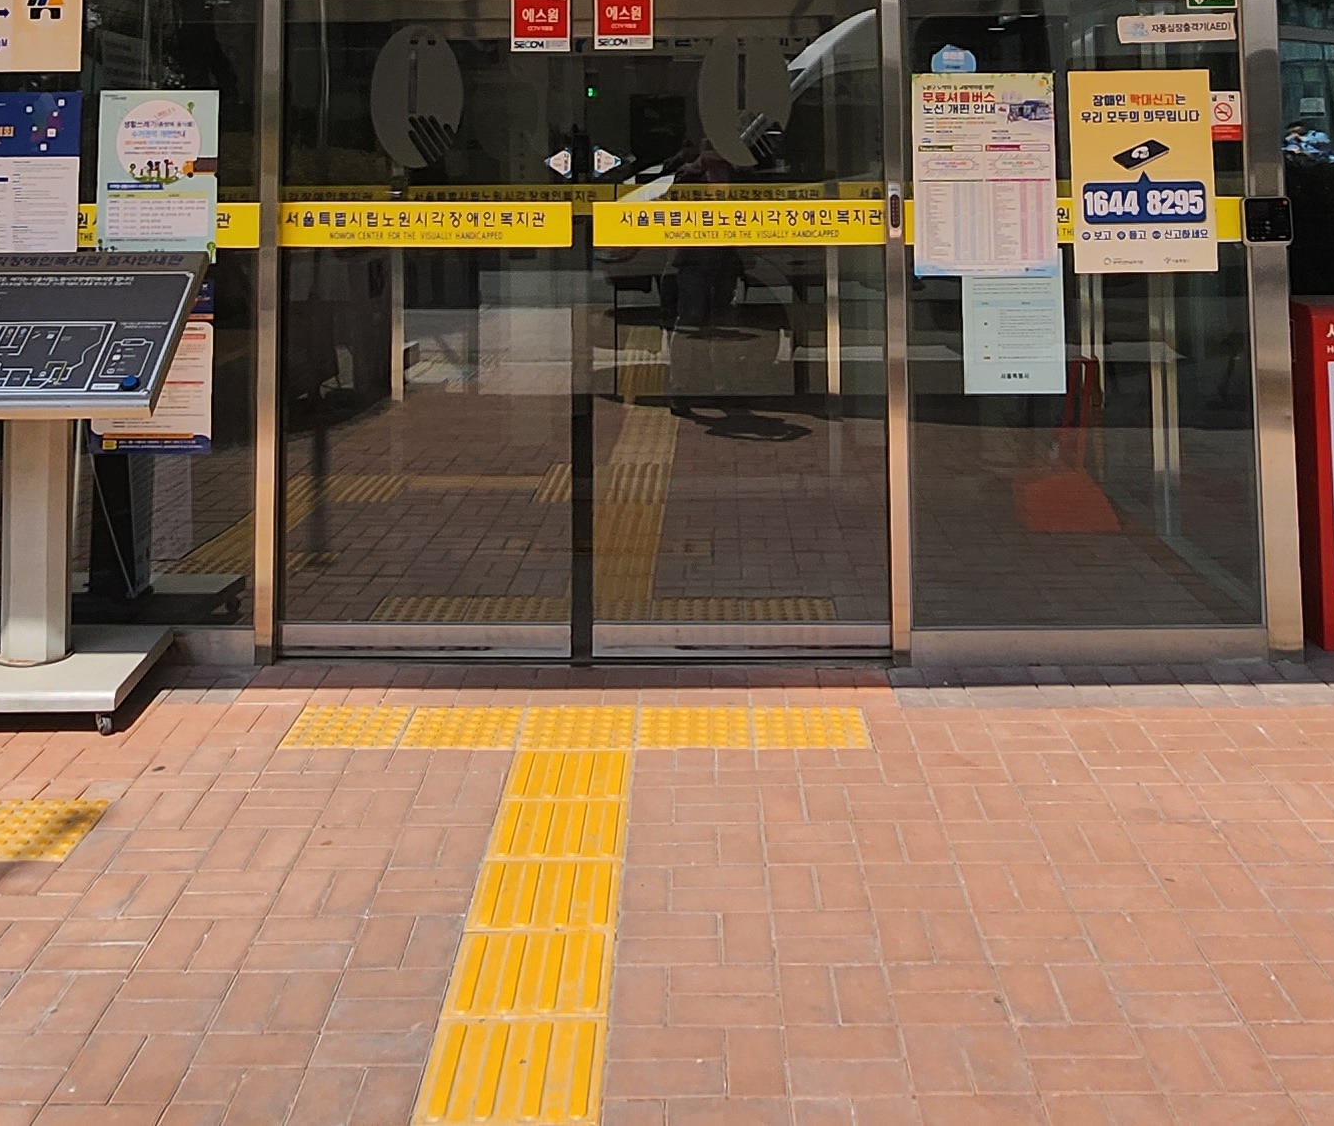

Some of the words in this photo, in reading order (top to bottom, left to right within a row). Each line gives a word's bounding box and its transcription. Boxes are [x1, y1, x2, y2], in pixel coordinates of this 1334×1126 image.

[522, 7, 558, 23] 에스원
[605, 5, 641, 21] 에스원
[1151, 21, 1231, 33] 자동심장충격기(AED)
[514, 41, 544, 49] SECOM
[598, 38, 627, 46] SECOM
[922, 91, 995, 103] 무료셔틀버스
[1092, 94, 1126, 106] 장애인
[1129, 94, 1186, 106] 학대신고는
[923, 104, 944, 114] 노선
[947, 104, 969, 114] 개편
[973, 103, 996, 114] 안내
[1081, 111, 1102, 123] 우리
[1106, 111, 1139, 123] 모두의
[1143, 110, 1199, 122] 의무입니다
[1084, 190, 1139, 216] 1644
[1147, 189, 1204, 215] 8295
[285, 211, 546, 228] 서울특별시립노원시각장애인복지관
[620, 209, 883, 227] 서울특별시립노원시각장애인복지관
[1057, 207, 1070, 223] 원
[329, 231, 356, 241] NOWON
[358, 231, 384, 241] CENTER
[388, 231, 401, 241] FOR
[403, 231, 416, 241] THE
[420, 231, 452, 241] VISUALLY
[455, 231, 503, 241] HANDICAPPED
[664, 230, 692, 239] NOWON
[693, 230, 719, 239] CENTER
[723, 230, 737, 239] FOR
[739, 230, 752, 239] THE
[757, 230, 788, 239] VISUALLY
[1093, 230, 1111, 241] 보고
[1129, 230, 1147, 240] 듣고
[1164, 229, 1208, 239] 신고하세요
